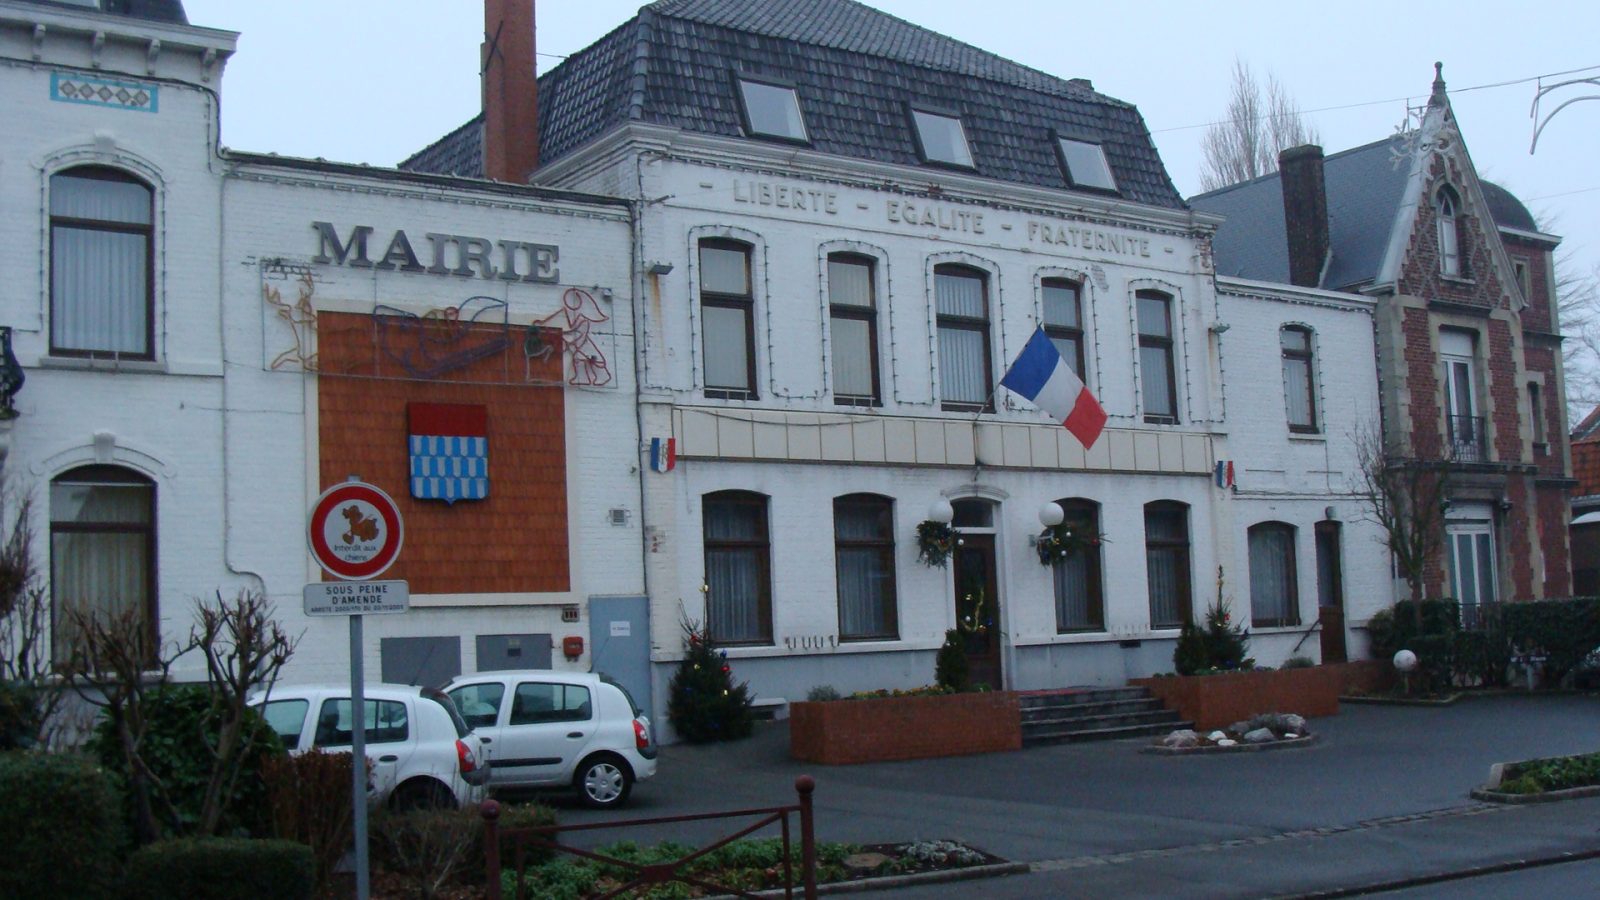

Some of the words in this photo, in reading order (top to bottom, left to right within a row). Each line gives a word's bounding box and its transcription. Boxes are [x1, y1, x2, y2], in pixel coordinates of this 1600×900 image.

[733, 178, 838, 214] LIBERTE
[886, 199, 985, 235] EGALITE
[1027, 219, 1151, 258] FRATERNITE
[311, 220, 560, 284] MAIRIE
[326, 585, 353, 595] SOUS
[359, 584, 388, 594] PEINE
[332, 595, 382, 605] D'AMENDE
